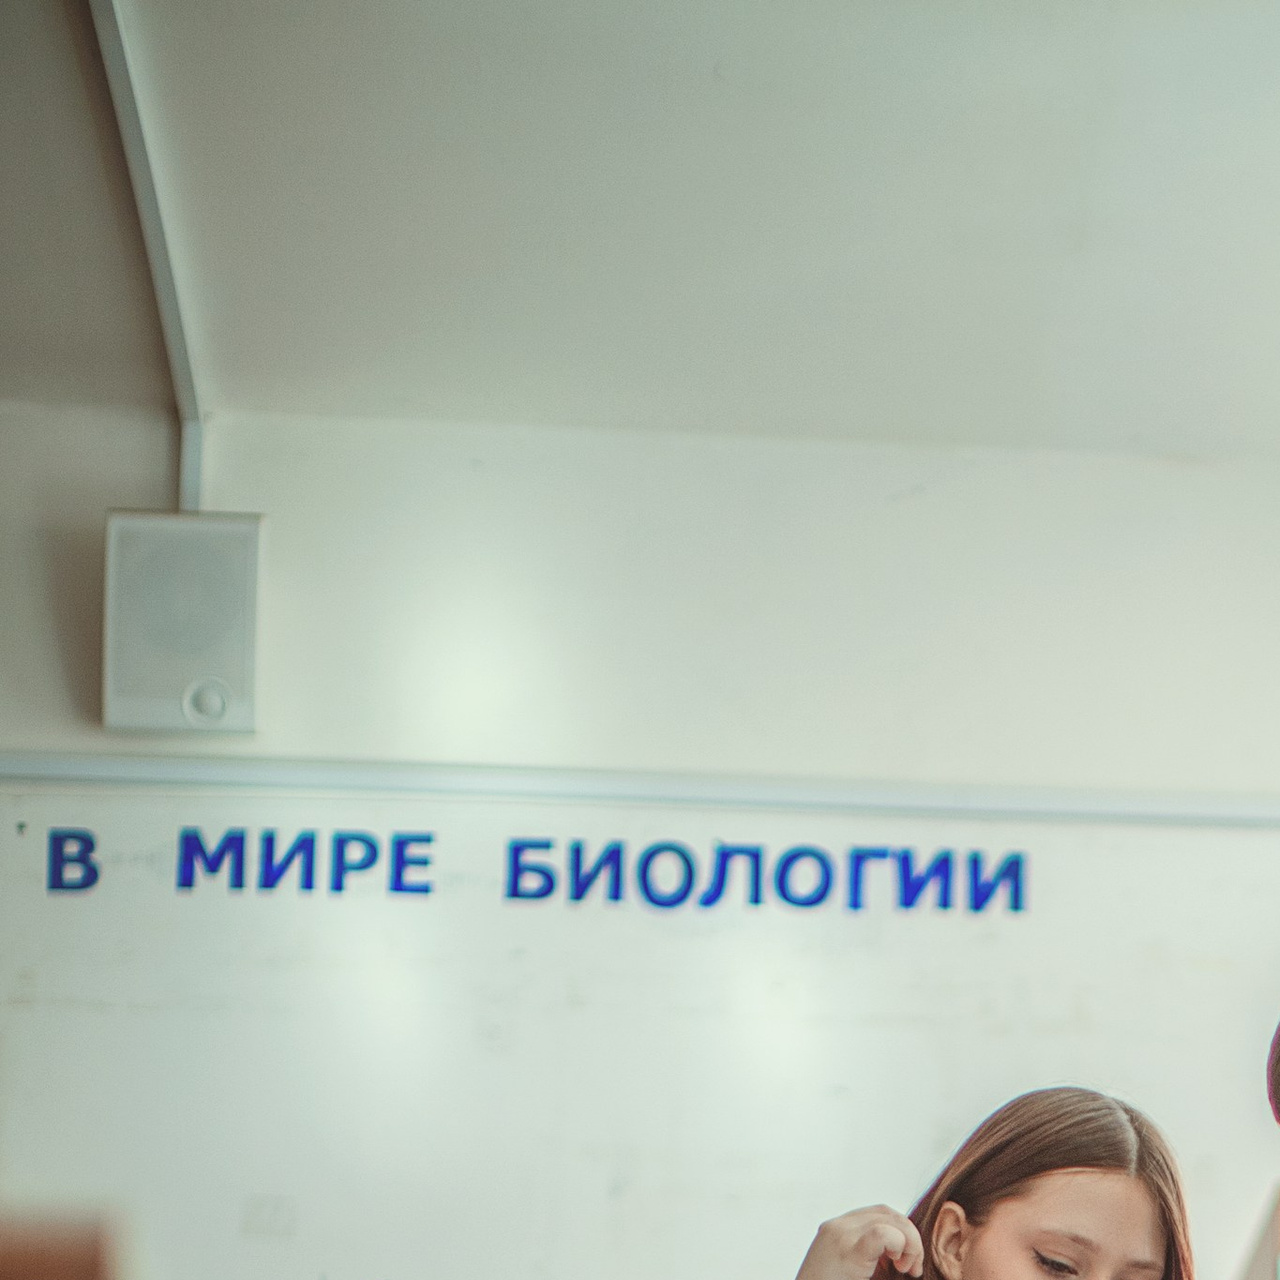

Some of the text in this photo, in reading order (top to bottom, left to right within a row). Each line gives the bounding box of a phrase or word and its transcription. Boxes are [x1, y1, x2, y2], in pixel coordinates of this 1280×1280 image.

[46, 826, 1028, 912] В МИРЕ БИОЛОГИИ
